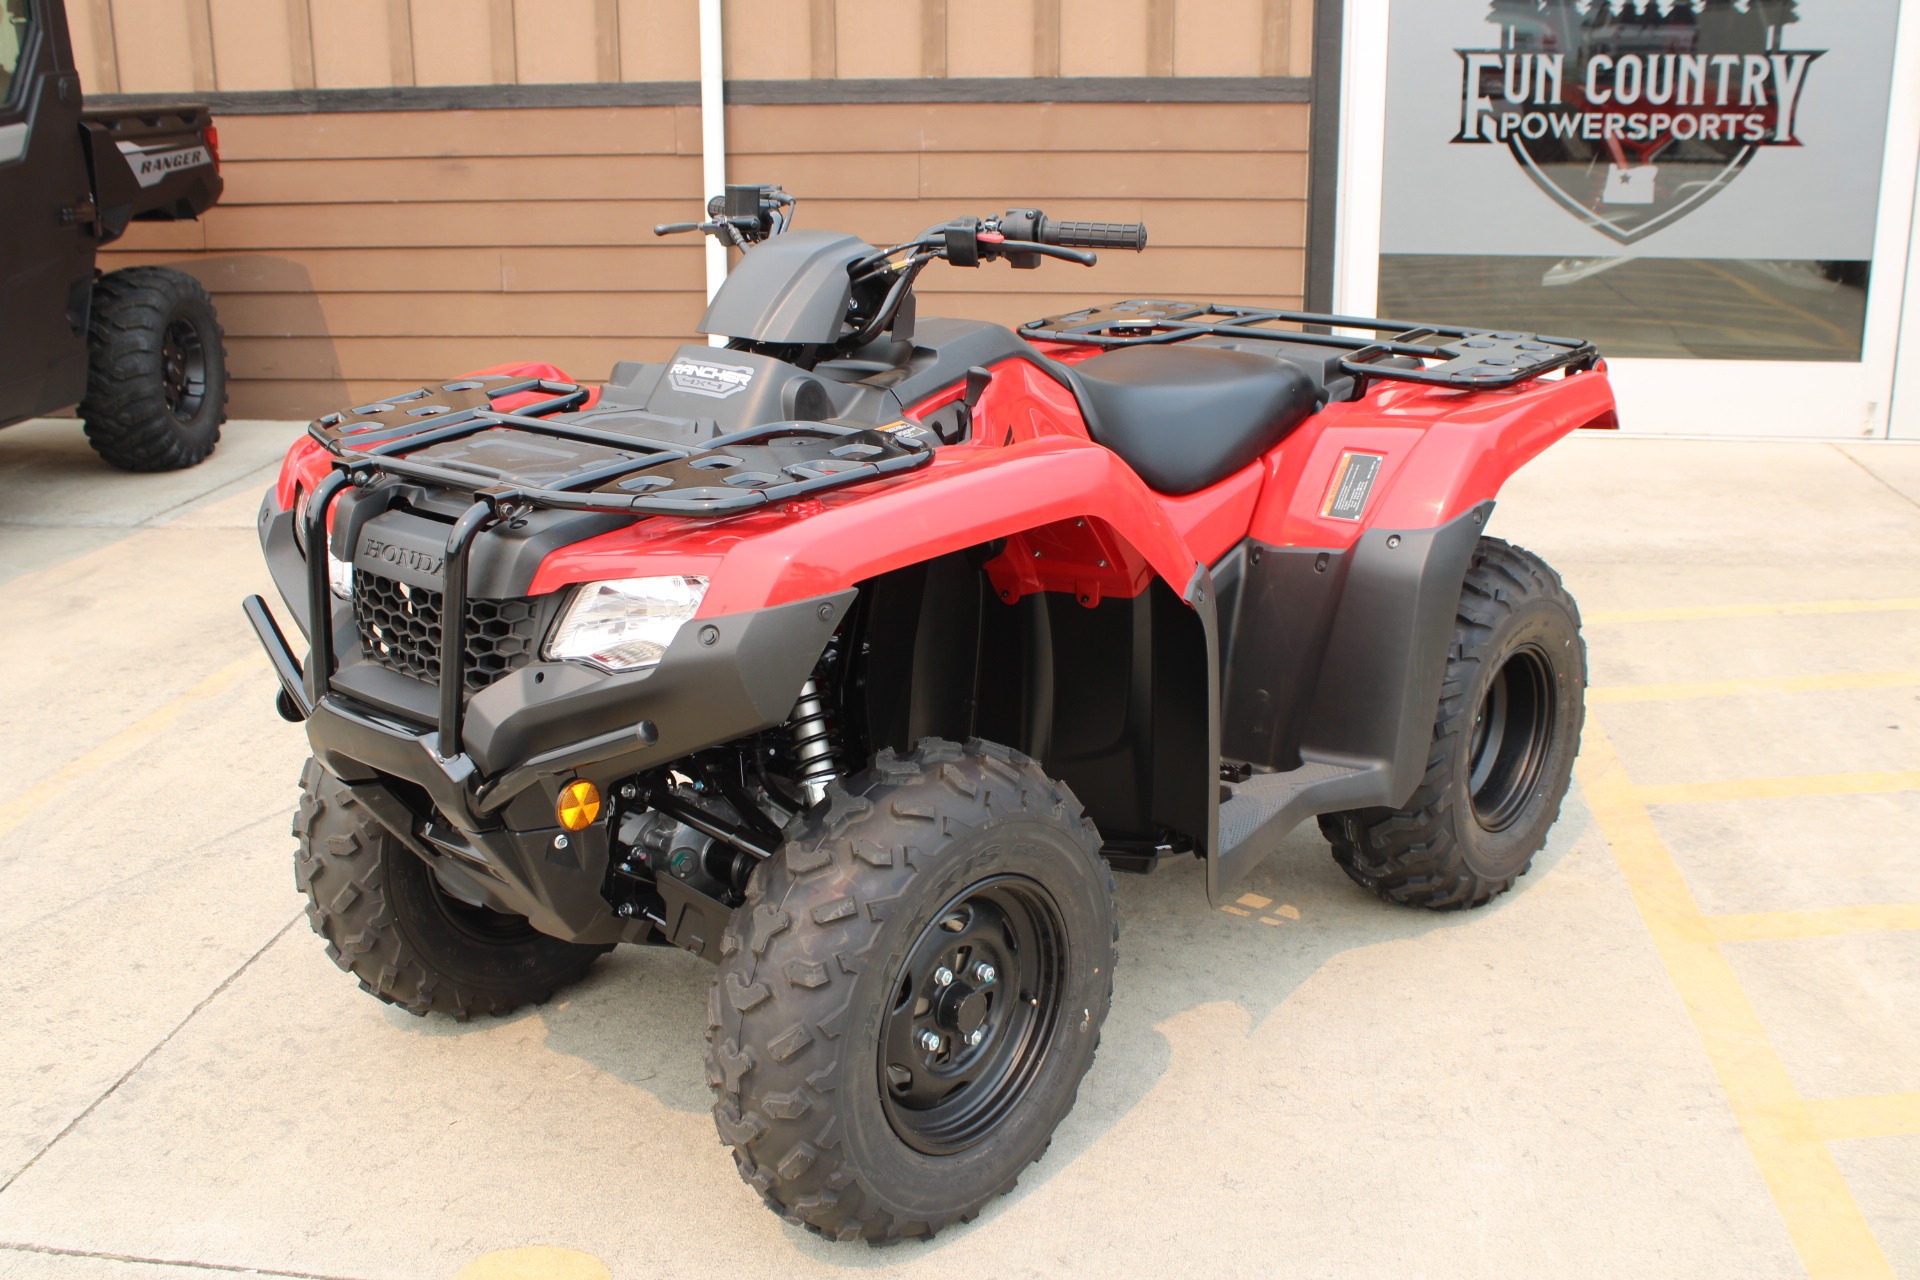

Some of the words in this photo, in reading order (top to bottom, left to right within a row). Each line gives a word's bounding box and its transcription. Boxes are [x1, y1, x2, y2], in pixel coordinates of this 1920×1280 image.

[1461, 53, 1564, 140] FUN
[1585, 53, 1811, 142] COUNTRY
[1500, 111, 1766, 141] POWERSPORTS
[141, 151, 201, 174] RANGER
[670, 364, 752, 386] RANCHER
